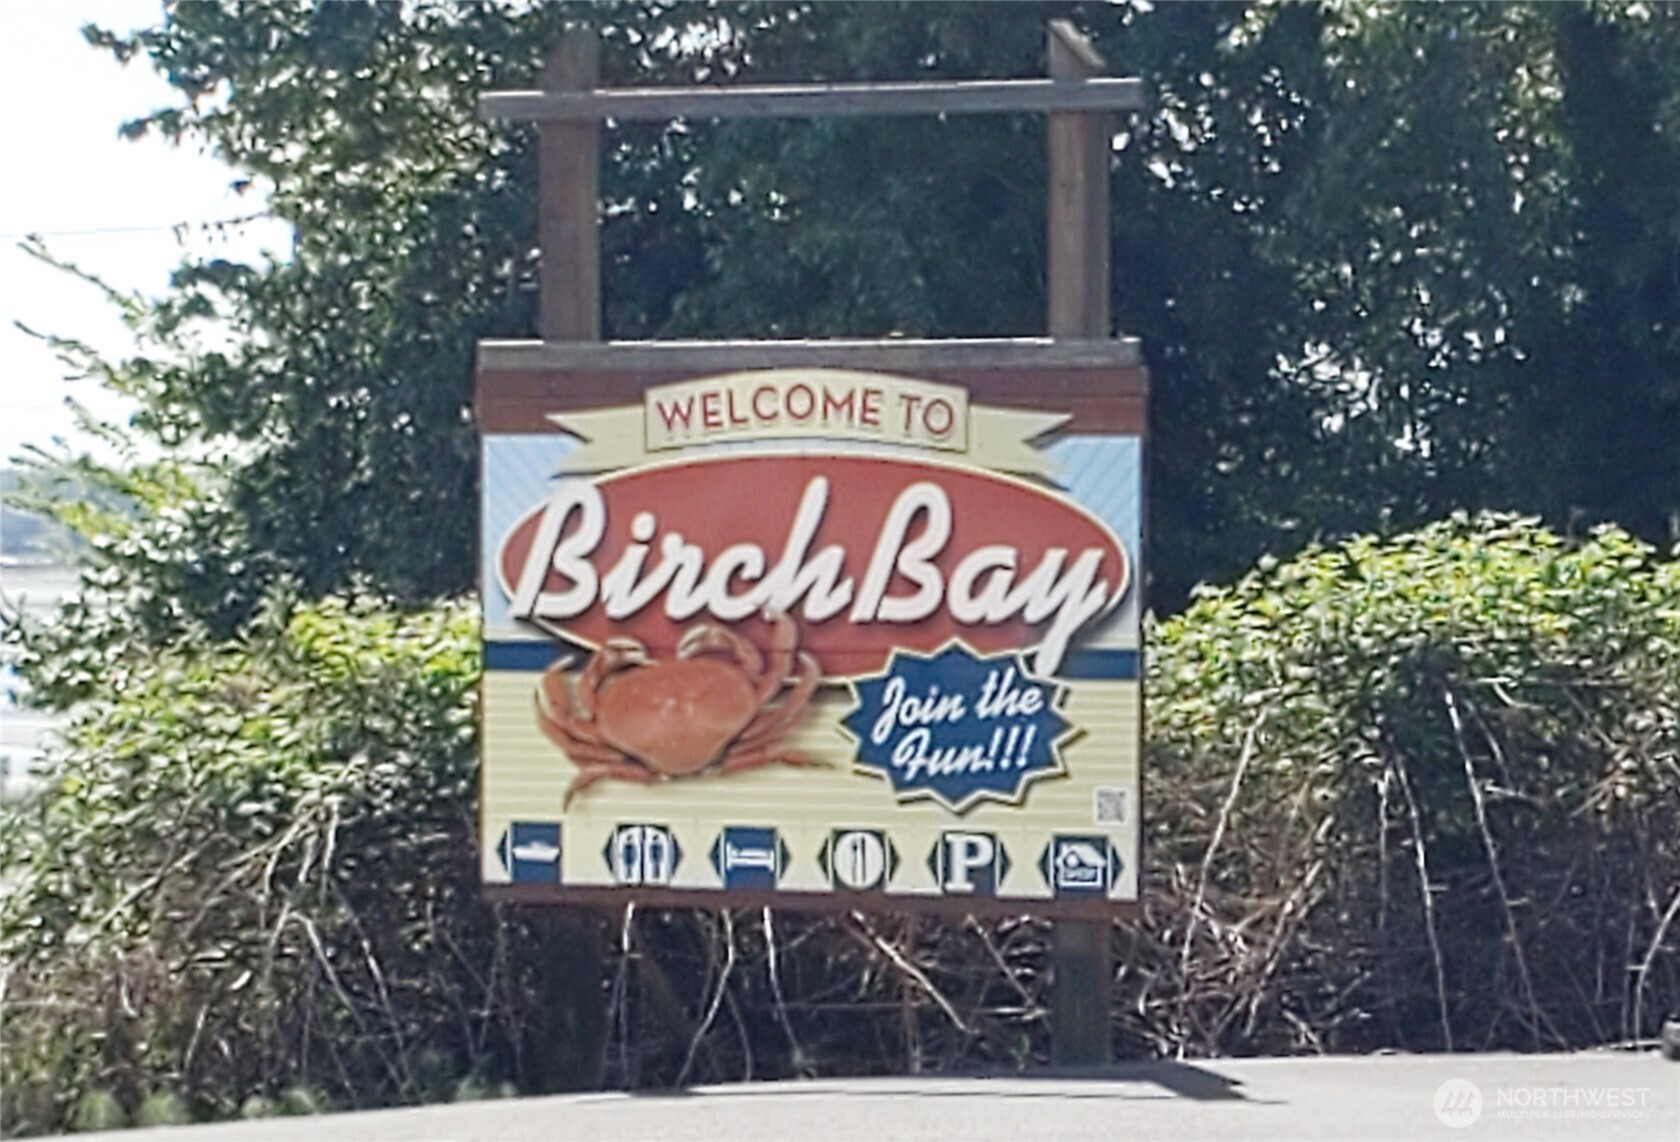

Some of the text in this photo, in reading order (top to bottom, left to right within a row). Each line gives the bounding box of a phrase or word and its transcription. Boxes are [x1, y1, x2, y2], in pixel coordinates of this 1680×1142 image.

[655, 383, 954, 435] WELCOME TO
[510, 475, 1109, 677] Birch Bay
[870, 667, 1043, 744] Join the
[891, 724, 1037, 781] Fun!!!
[944, 833, 994, 892] P
